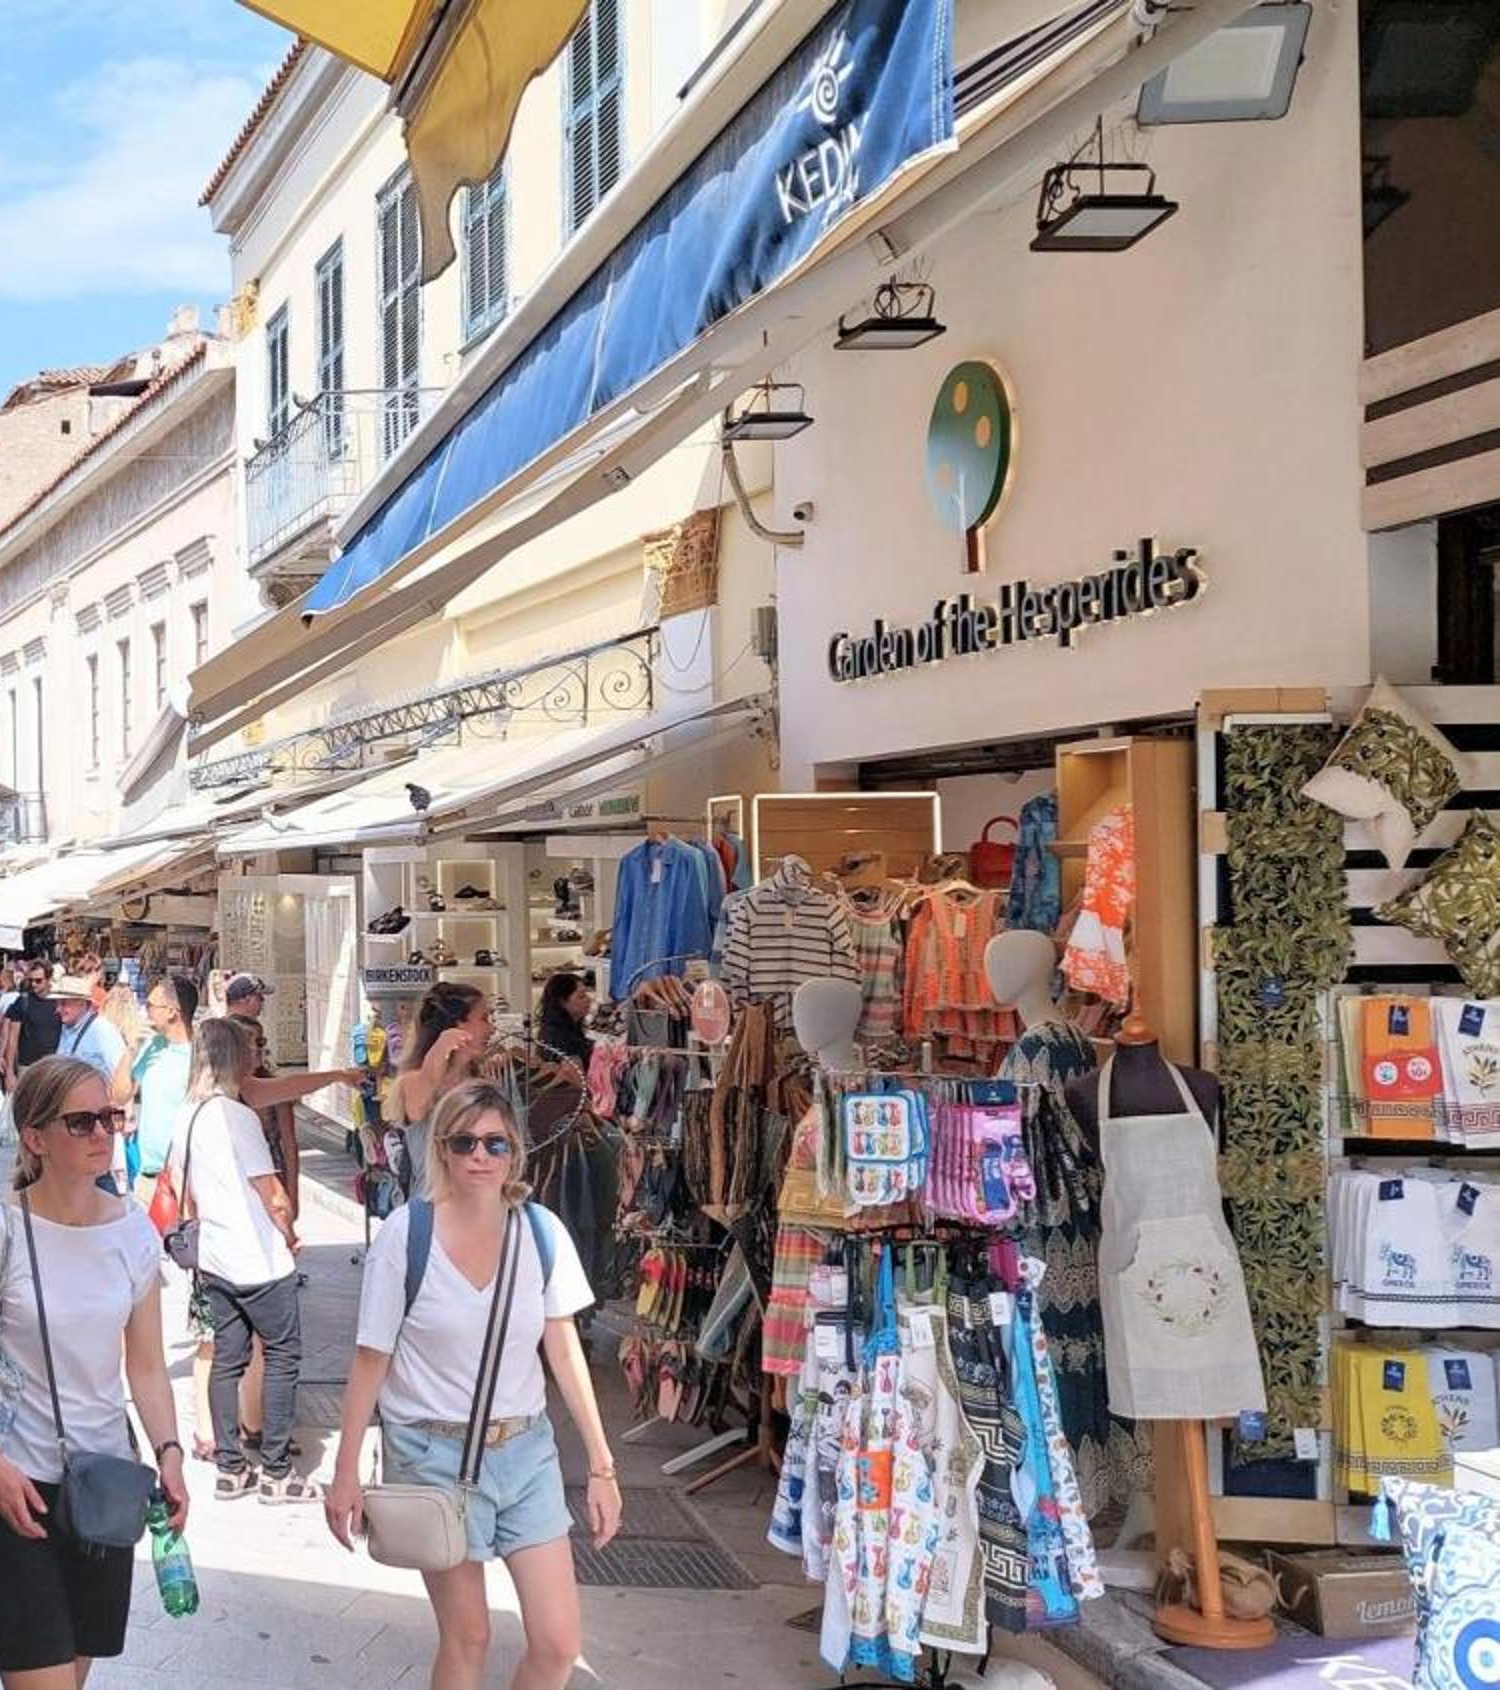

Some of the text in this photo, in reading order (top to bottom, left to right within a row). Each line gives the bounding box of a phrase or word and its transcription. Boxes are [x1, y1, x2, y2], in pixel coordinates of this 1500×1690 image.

[828, 535, 1206, 684] Garden of the Hesperides
